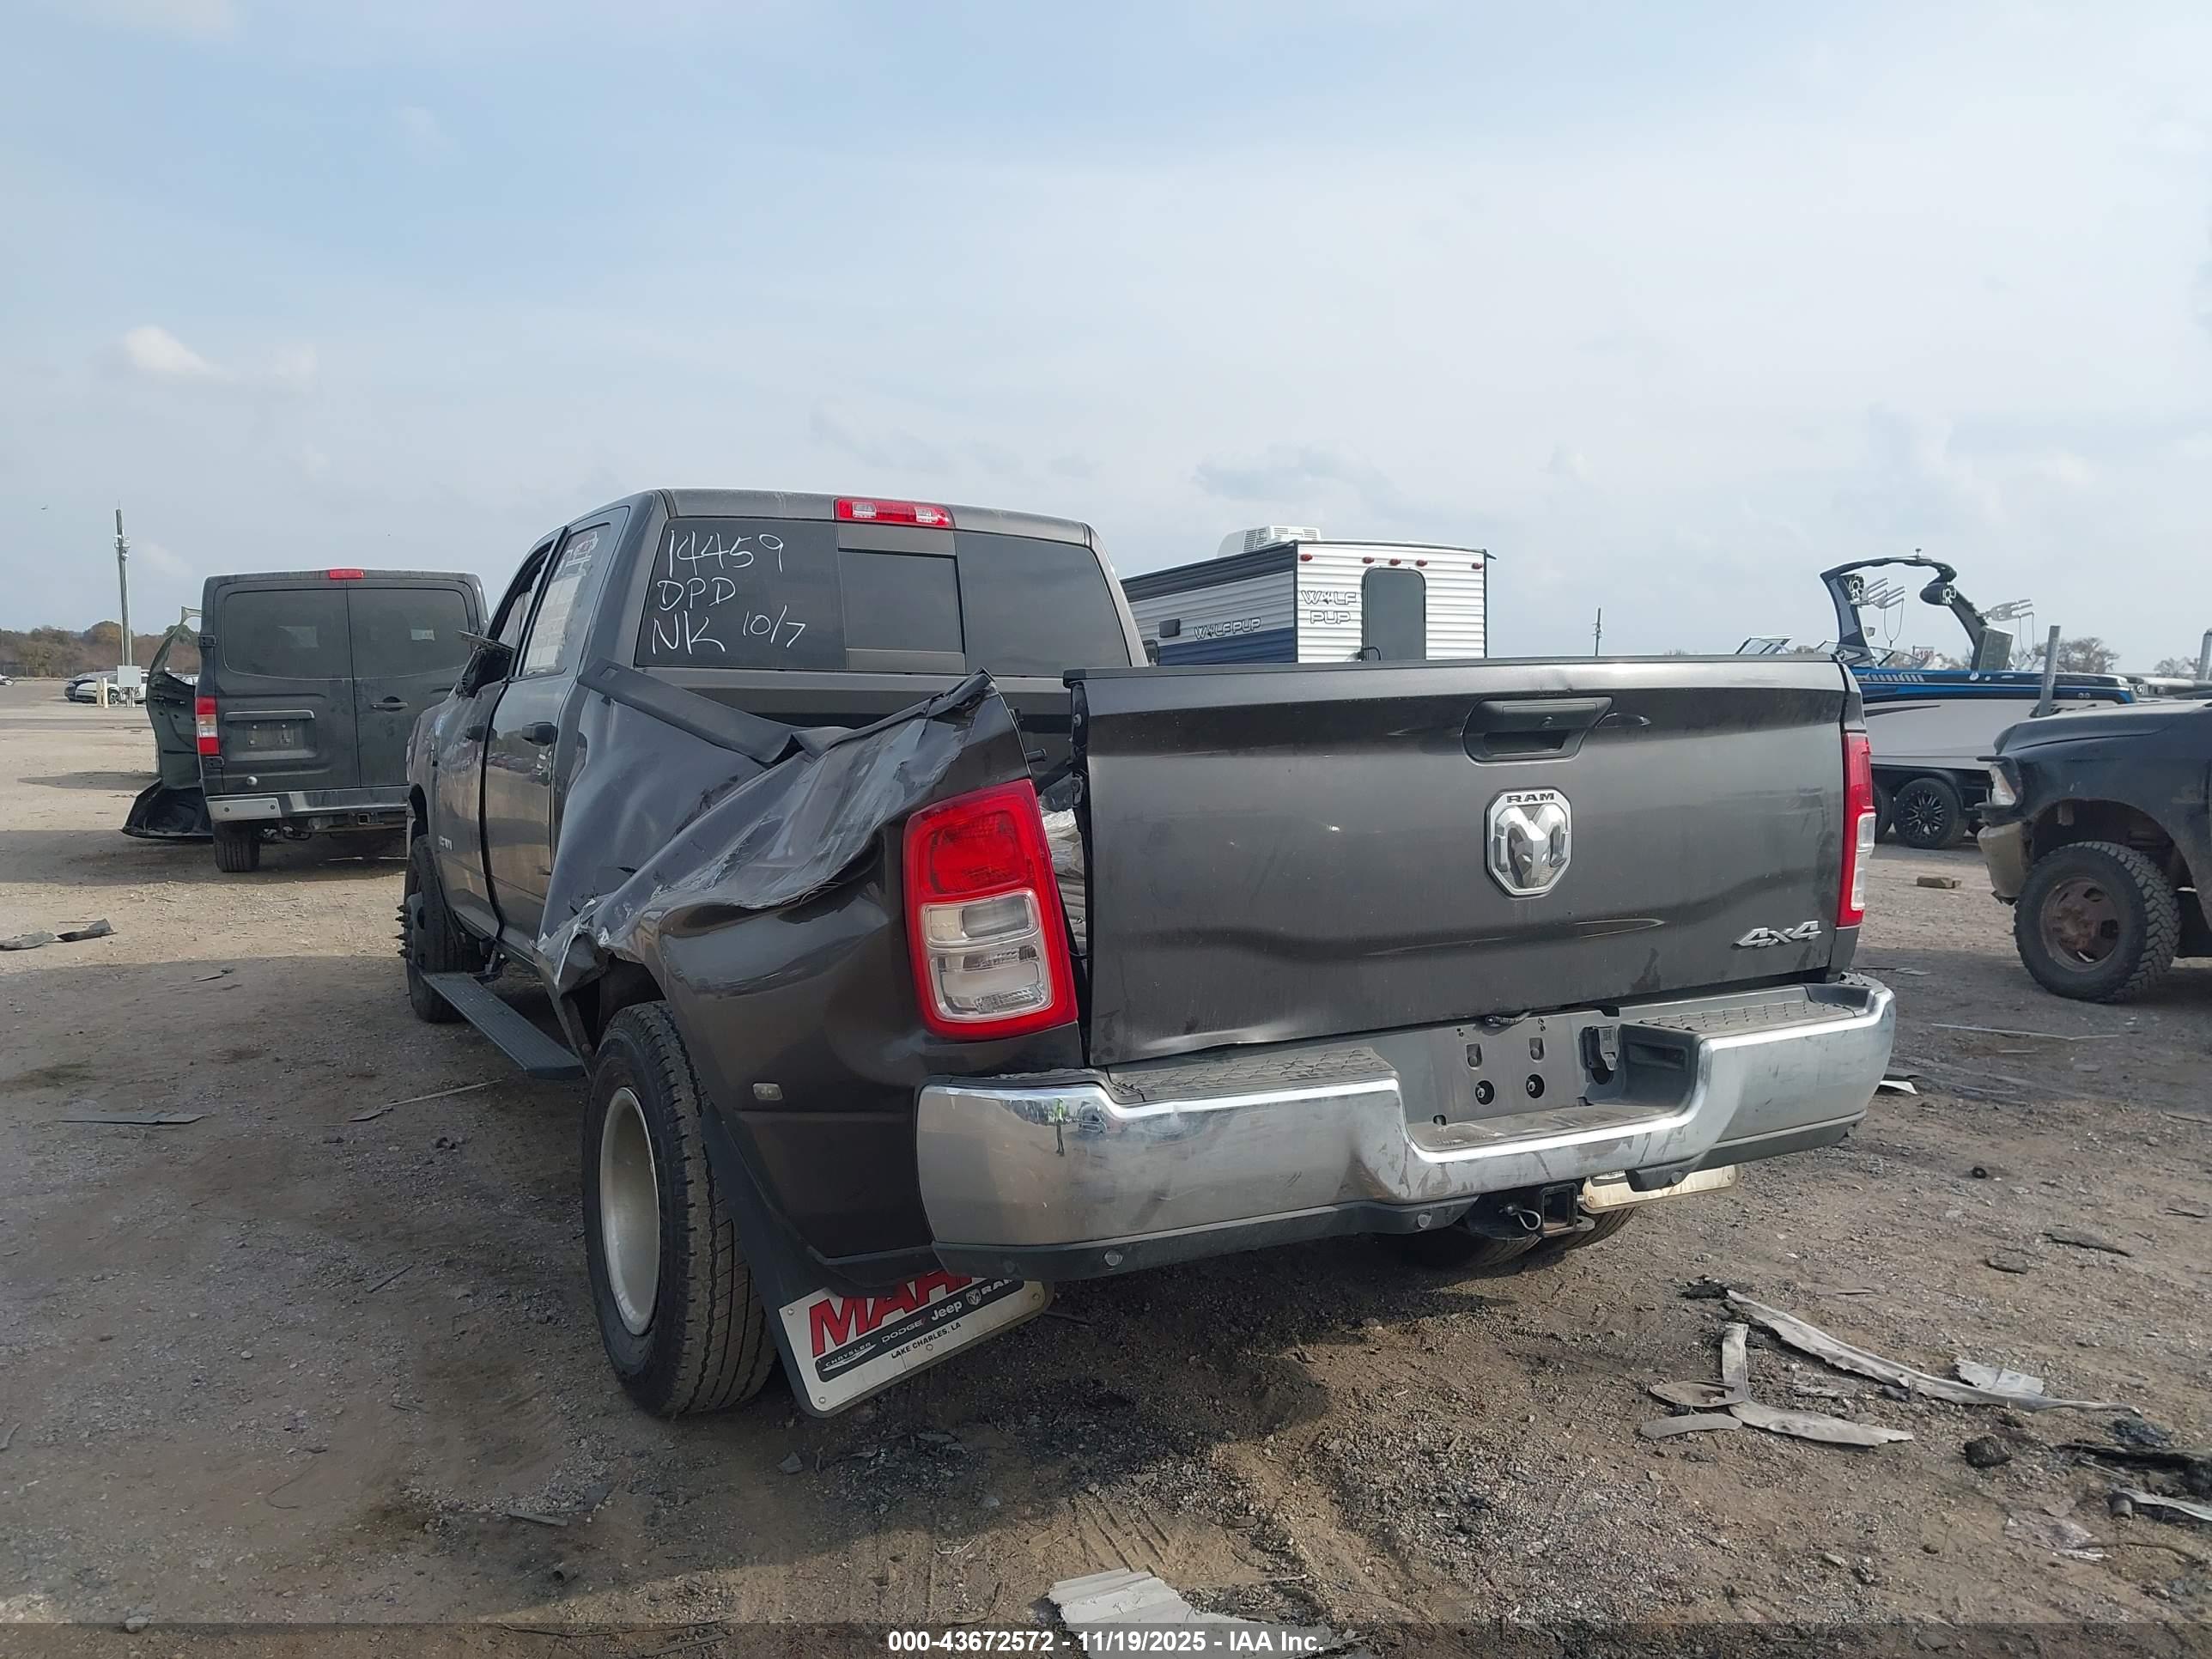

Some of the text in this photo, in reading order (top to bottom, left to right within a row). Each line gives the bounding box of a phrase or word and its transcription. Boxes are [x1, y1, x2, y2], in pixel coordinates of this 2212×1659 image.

[669, 529, 784, 578] 14459
[743, 605, 806, 648] 10/7
[1232, 617, 1261, 635] PUP
[1310, 611, 1351, 624] PUP
[1506, 793, 1555, 804] RAM
[825, 1341, 872, 1368] CHRYSLER
[881, 1319, 923, 1344] DODGE
[931, 1300, 963, 1321] Jeep
[890, 1346, 911, 1359] LAKE
[951, 1322, 962, 1331] LA
